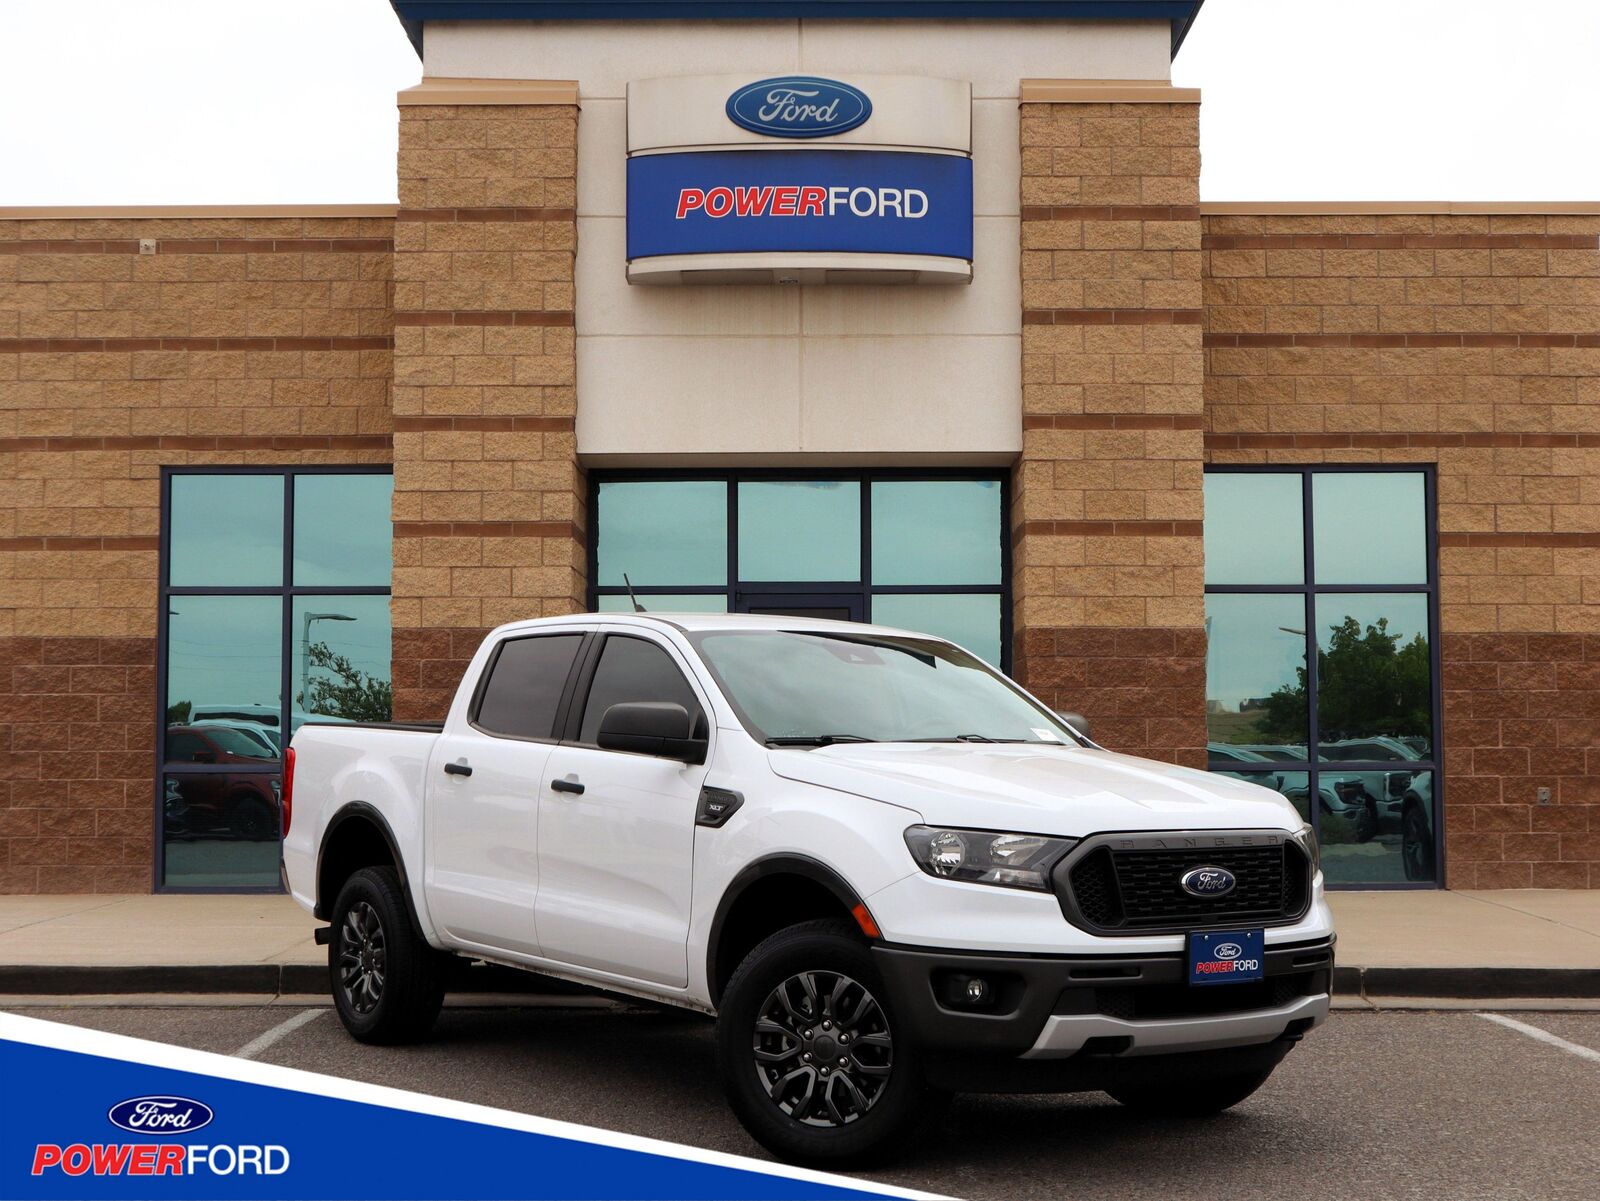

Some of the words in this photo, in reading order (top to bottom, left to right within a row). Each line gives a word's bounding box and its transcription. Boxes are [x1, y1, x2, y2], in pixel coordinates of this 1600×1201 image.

[758, 88, 841, 124] Ford
[1120, 835, 1279, 849] RANGER
[1197, 872, 1226, 890] Ford
[1219, 945, 1237, 956] Ford
